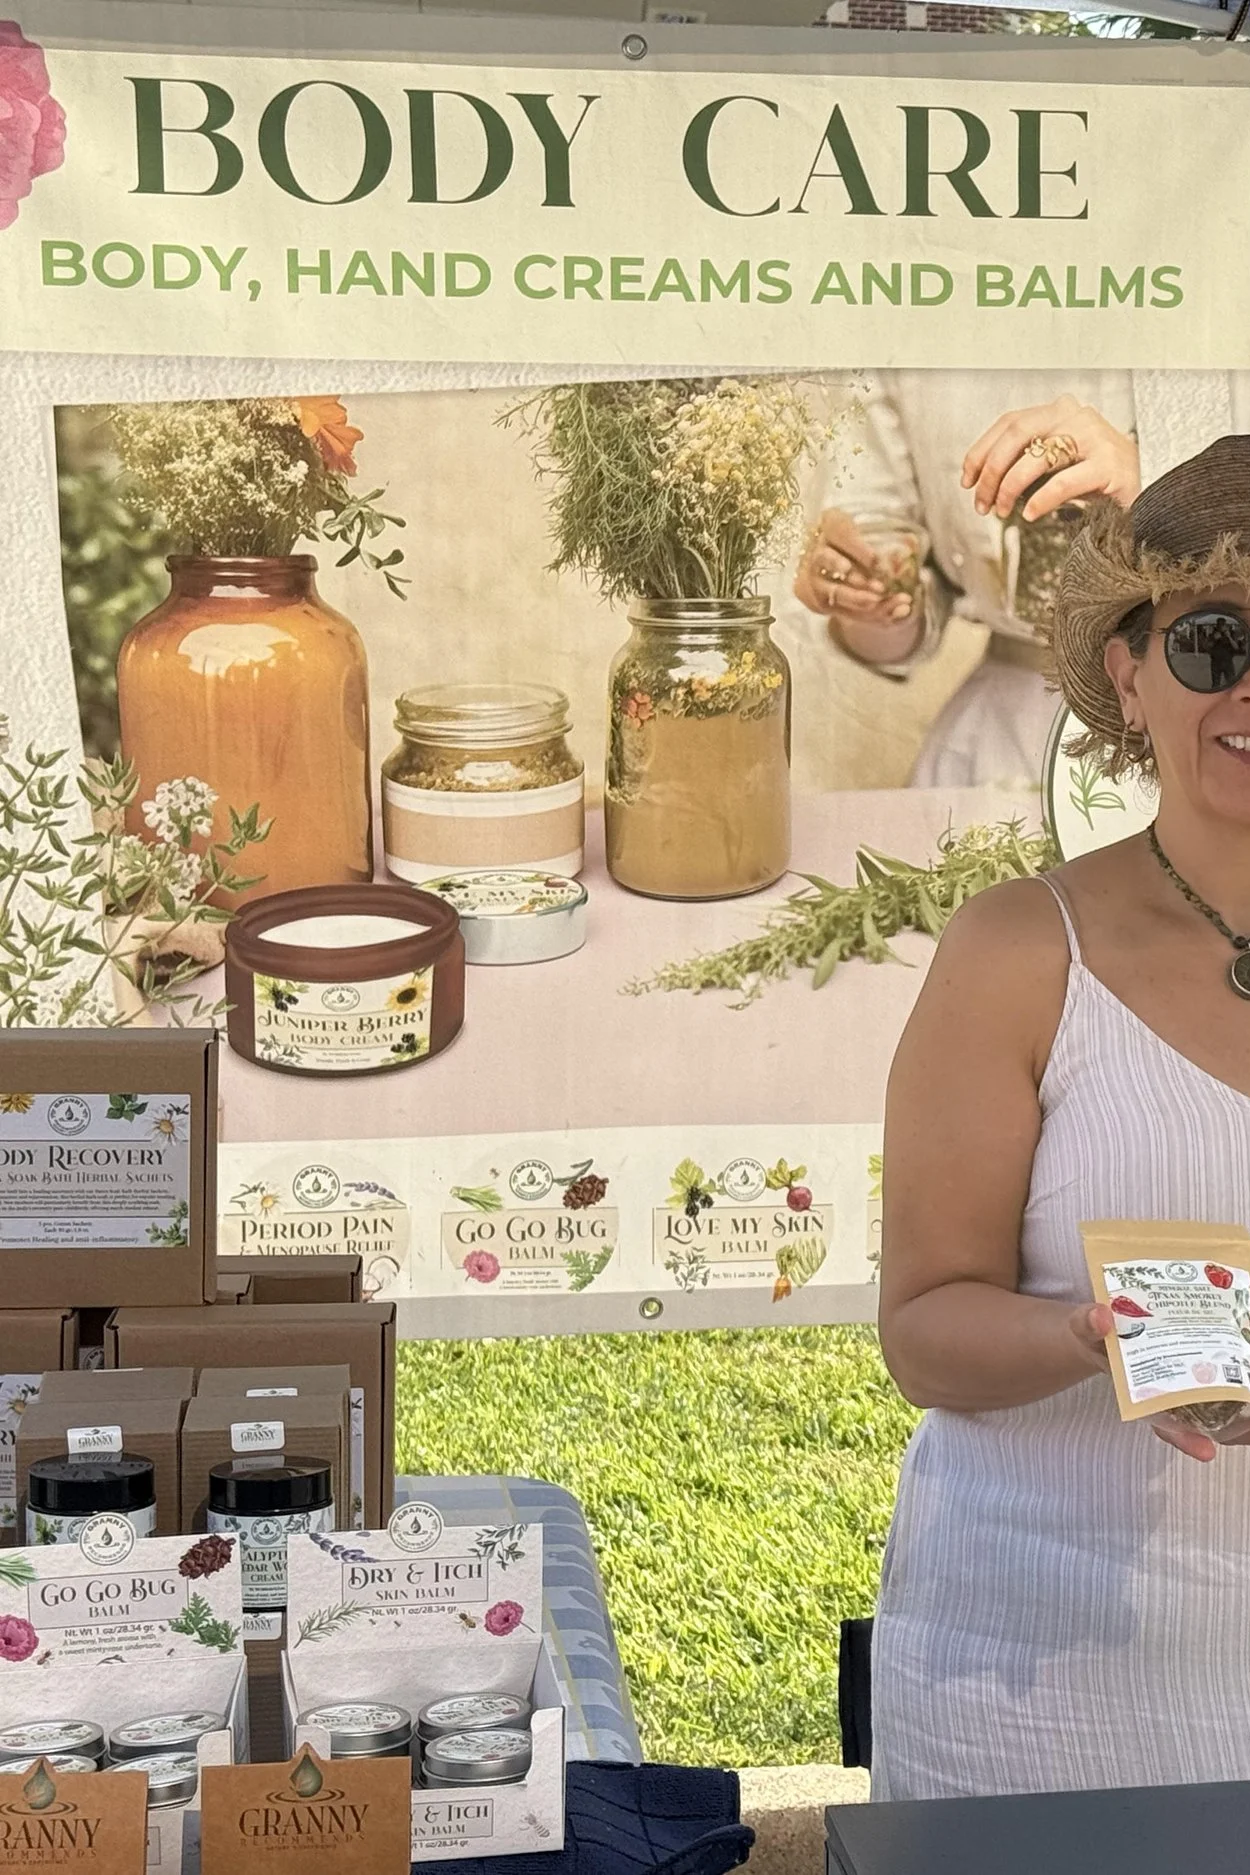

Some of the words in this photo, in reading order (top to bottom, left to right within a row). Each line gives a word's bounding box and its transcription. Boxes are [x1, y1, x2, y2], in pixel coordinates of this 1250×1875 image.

[123, 76, 601, 207] BODY
[682, 95, 1088, 219] CARE
[41, 239, 261, 300] BODY,
[287, 248, 492, 298] HAND
[513, 254, 792, 304] CREAMS
[810, 262, 953, 308] AND
[976, 264, 1184, 309] BALMS
[257, 1009, 348, 1031] JUNIPER
[357, 1007, 428, 1034] BERRY
[290, 1034, 331, 1046] BODY
[339, 1033, 395, 1046] CREAM
[0, 1149, 37, 1166] ODY
[49, 1145, 166, 1171] RECOVERY
[42, 1172, 72, 1185] BATH
[77, 1172, 119, 1184] HERBAL
[126, 1172, 174, 1184] SACHETS
[241, 1220, 332, 1242] PERIOD
[343, 1216, 394, 1239] PAIN
[456, 1218, 495, 1244] GO
[506, 1216, 545, 1242] GO
[555, 1216, 607, 1244] BUG
[664, 1215, 720, 1244] LOVE
[730, 1217, 762, 1234] MY
[772, 1212, 824, 1238] SKIN
[346, 1239, 395, 1254] RELIEF
[509, 1247, 554, 1260] BALM
[722, 1240, 768, 1253] BALM
[397, 1507, 434, 1520] GRANNY
[87, 1517, 126, 1531] GRANNY
[250, 1574, 283, 1582] CREAM
[348, 1565, 397, 1589] DRY
[406, 1563, 425, 1585] &
[434, 1562, 483, 1583] ITCH
[40, 1584, 77, 1607] GO
[85, 1581, 121, 1604] GO
[129, 1578, 176, 1602] BUG
[376, 1589, 408, 1602] SKIN
[415, 1586, 456, 1598] BALM
[89, 1604, 130, 1618] BALM
[242, 1618, 273, 1631] RANNY
[238, 1804, 370, 1837] GRANNY
[424, 1805, 441, 1823] &
[447, 1805, 488, 1821] ITCH
[0, 1818, 101, 1849] RANNY
[432, 1824, 465, 1835] BALM
[240, 1833, 366, 1847] RECOMMENDS
[6, 1849, 97, 1859] OMMENDS
